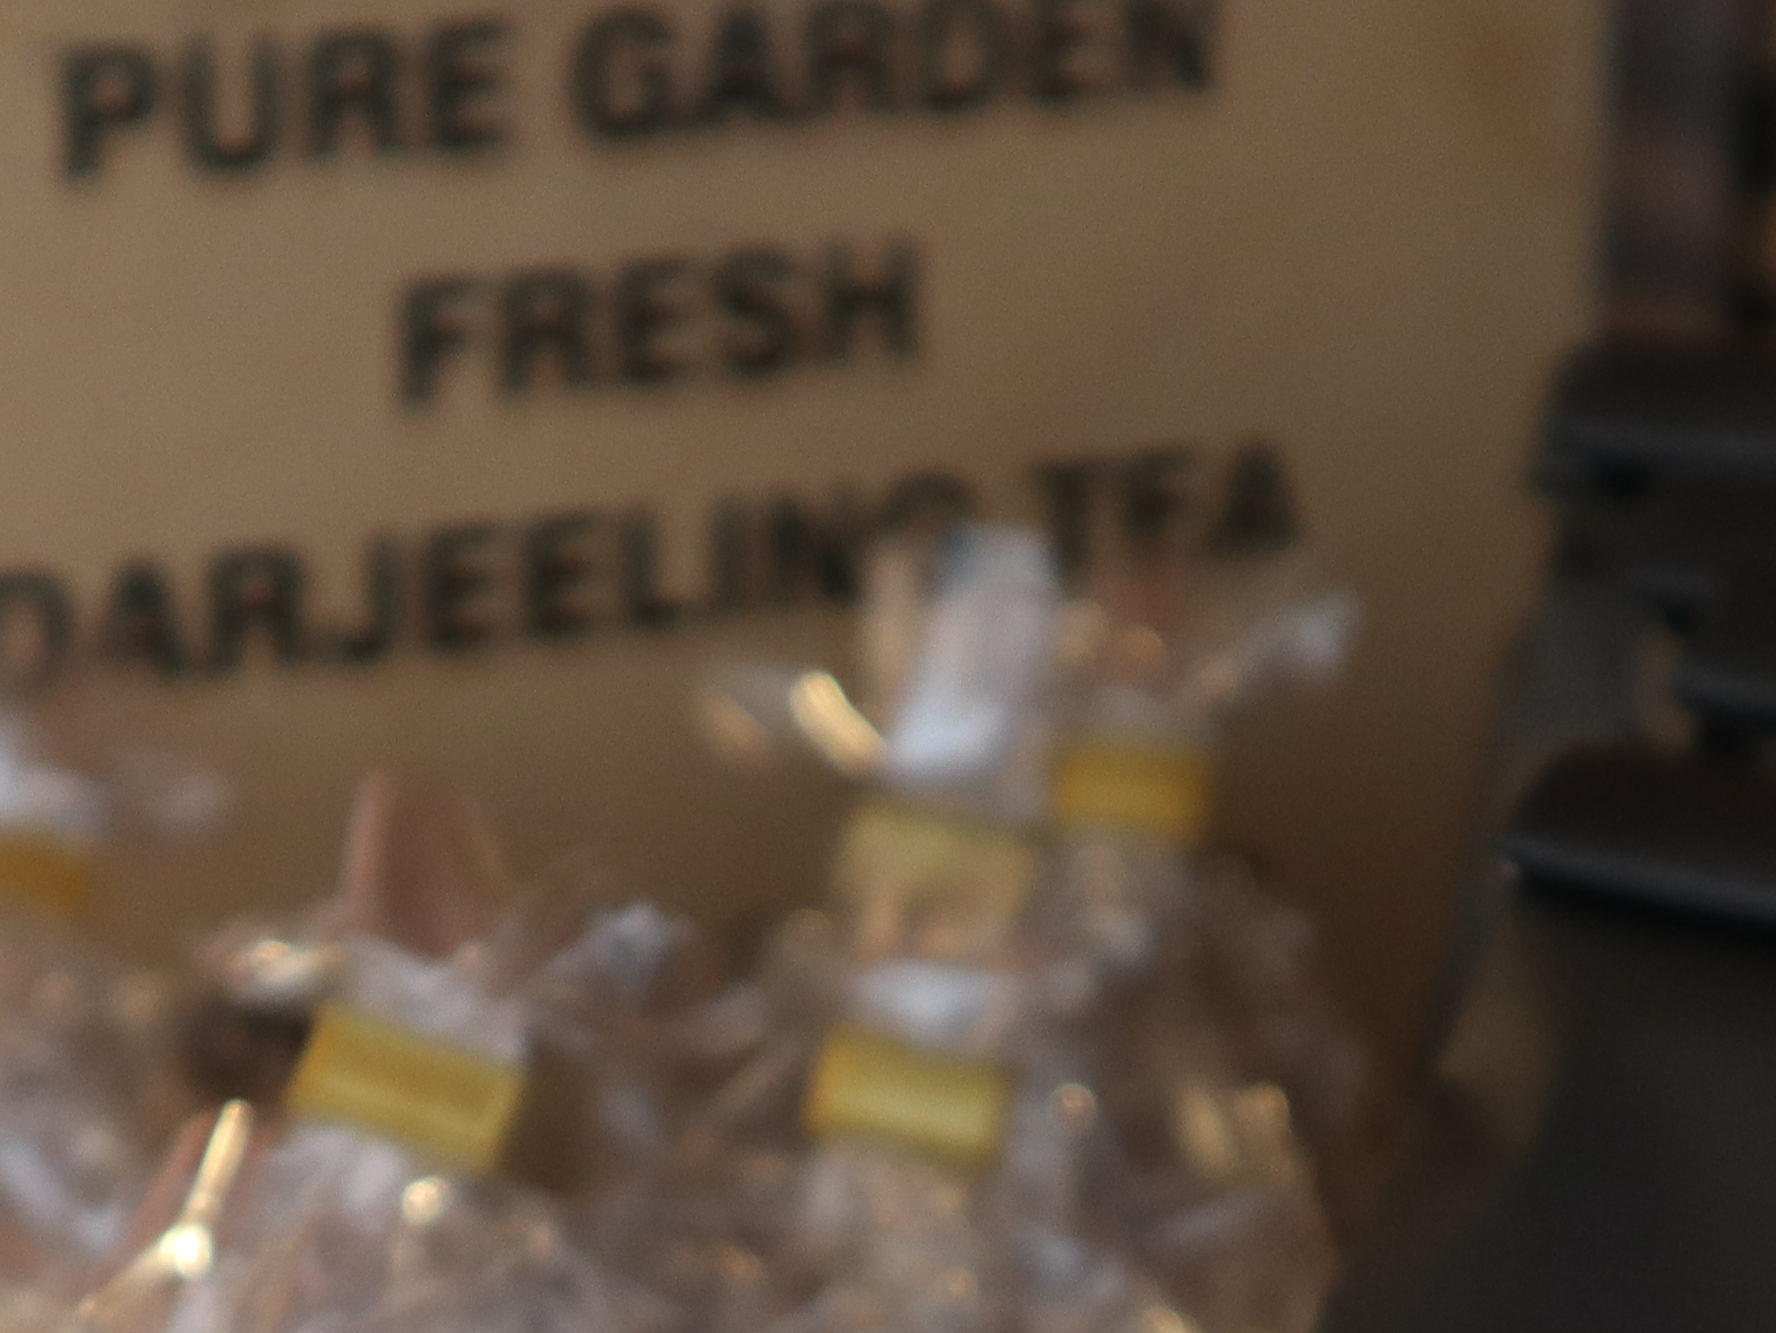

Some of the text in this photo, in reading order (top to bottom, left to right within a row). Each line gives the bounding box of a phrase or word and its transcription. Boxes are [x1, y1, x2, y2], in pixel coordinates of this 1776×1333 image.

[59, 0, 1216, 184] PURE GARDEN
[395, 240, 922, 410] FRESH
[1040, 443, 1304, 575] TEA
